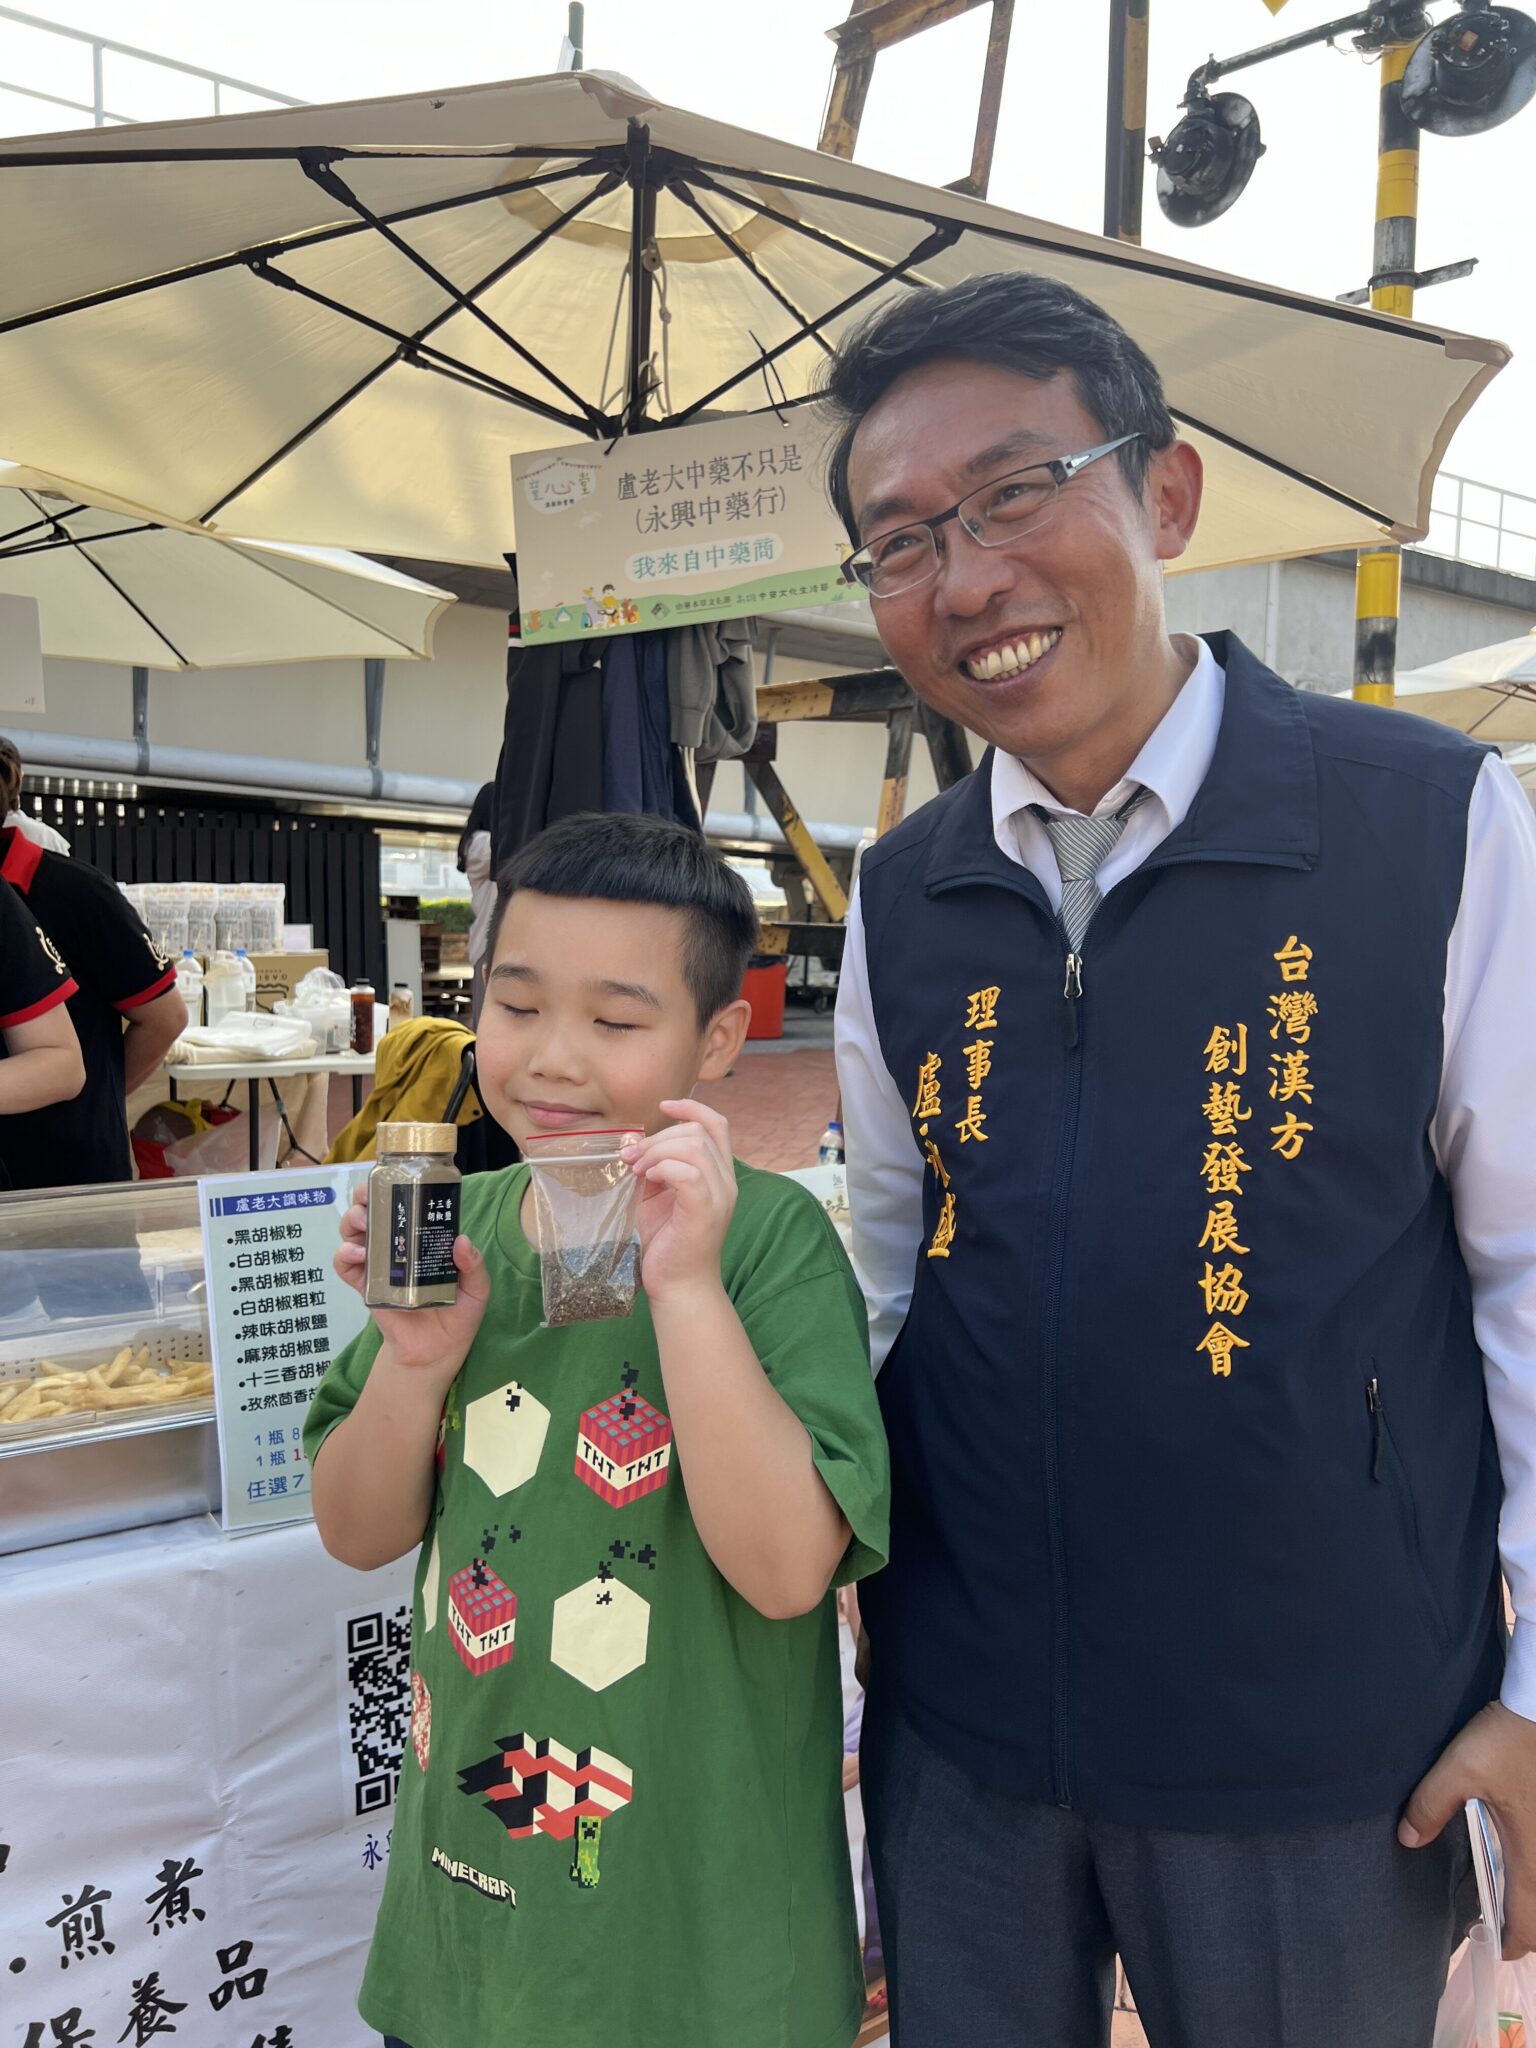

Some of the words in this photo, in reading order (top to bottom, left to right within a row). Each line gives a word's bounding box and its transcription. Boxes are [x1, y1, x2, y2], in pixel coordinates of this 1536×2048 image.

[617, 444, 802, 501] 盧老大中藥不只是
[635, 486, 786, 534] (永興中藥行)
[632, 537, 775, 580] 我來自中藥商
[954, 985, 1001, 1144] 理事長
[1267, 935, 1319, 1160] 台灣漢方
[236, 1190, 327, 1212] 盧老大調味粉
[1195, 1022, 1253, 1378] 創藝發展協會
[234, 1223, 303, 1246] 黑胡椒粉
[237, 1246, 305, 1269] 白胡椒粉
[238, 1267, 325, 1293] 黑胡椒粗粒
[240, 1290, 326, 1316] 白胡椒粗粒
[241, 1313, 328, 1341] 辣味胡椒鹽
[246, 1359, 335, 1388] 十三香胡椒
[583, 1440, 615, 1480] TNT
[625, 1449, 665, 1482] TNT
[451, 1603, 472, 1648] TNT
[479, 1625, 511, 1652] TNT
[431, 1846, 517, 1909] MINECRAFT
